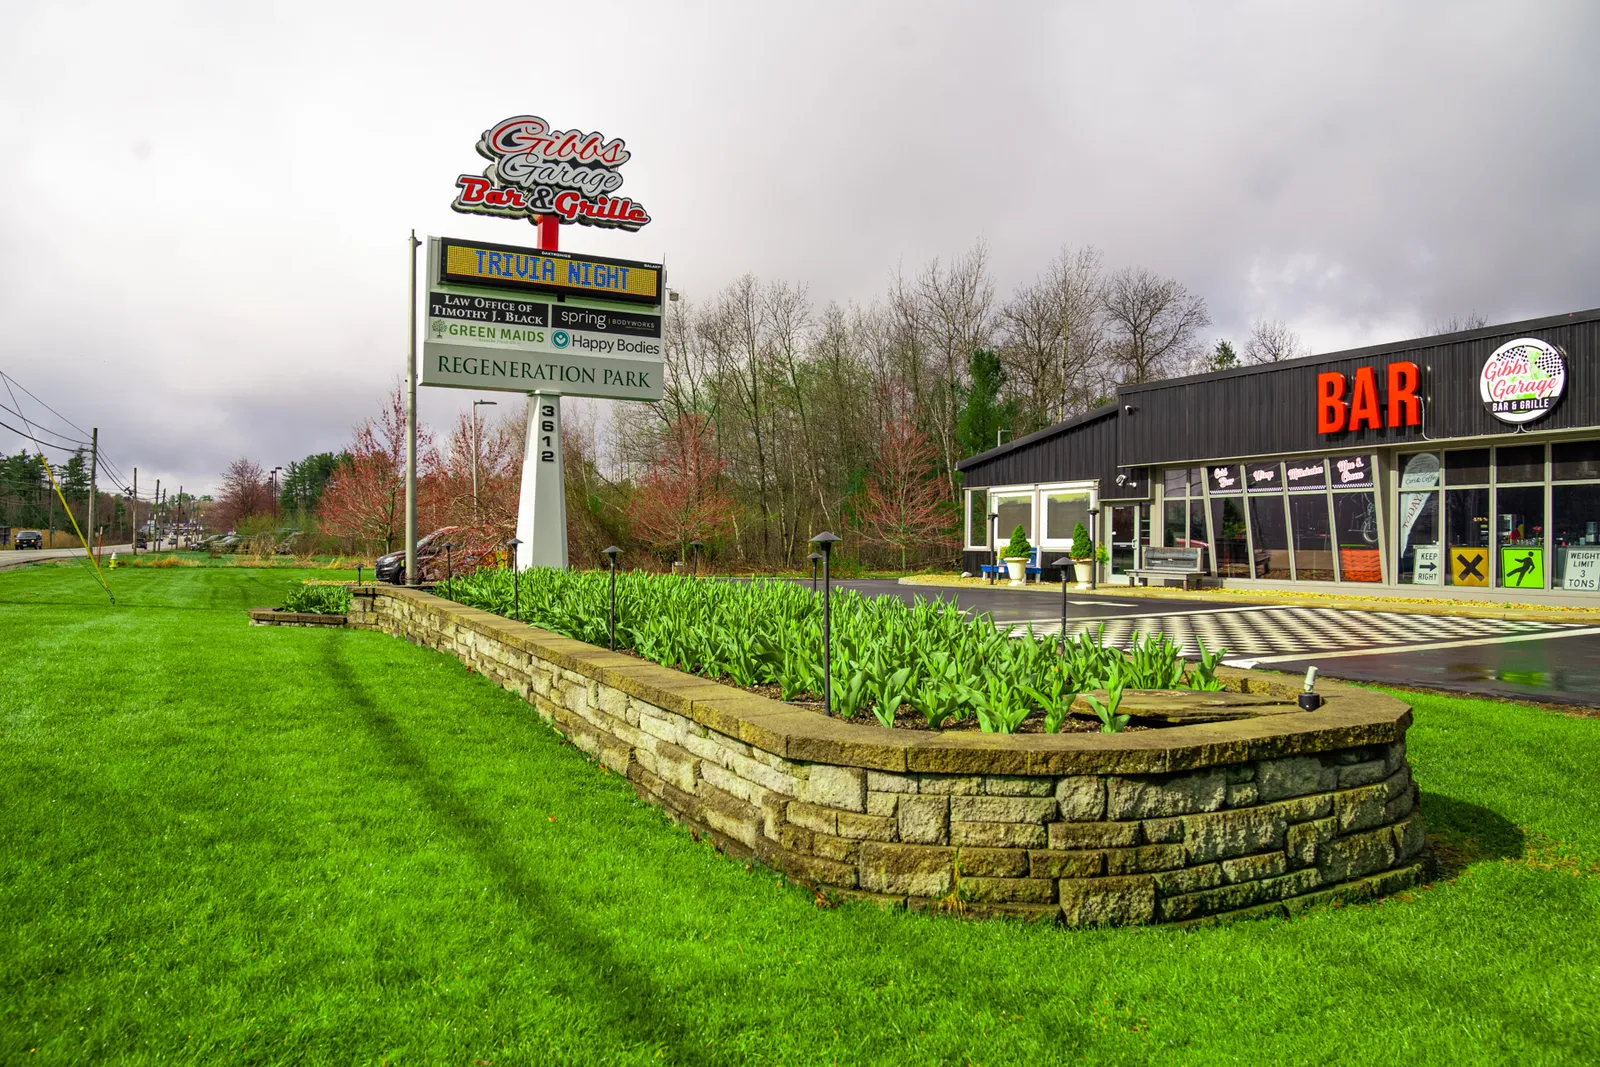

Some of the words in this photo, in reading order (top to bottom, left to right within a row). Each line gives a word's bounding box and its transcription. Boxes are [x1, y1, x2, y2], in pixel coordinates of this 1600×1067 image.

[492, 120, 627, 163] Gibbs
[502, 152, 620, 194] Garage
[459, 177, 526, 207] Bar
[530, 187, 553, 210] &
[554, 192, 650, 222] Grille
[475, 250, 555, 283] TRIVIA
[567, 261, 629, 291] NIGHT
[492, 311, 501, 322] J.
[561, 311, 607, 330] spring
[612, 319, 655, 328] BODYWORKS
[449, 324, 496, 339] GREEN
[500, 328, 545, 343] MAIDS
[572, 334, 614, 354] Happy
[617, 338, 660, 355] Bodies
[438, 355, 596, 384] REGENERATION
[603, 369, 651, 388] PARK
[1484, 358, 1529, 382] Gibbs
[1317, 361, 1421, 434] BAR
[1493, 377, 1559, 400] Garage
[1492, 402, 1509, 411] BAR
[1511, 401, 1517, 410] &
[1519, 398, 1549, 409] GRILLE
[541, 405, 555, 462] 3612
[1570, 552, 1600, 560] WEIGHT
[1569, 579, 1594, 588] TONS
[1580, 570, 1586, 578] 3
